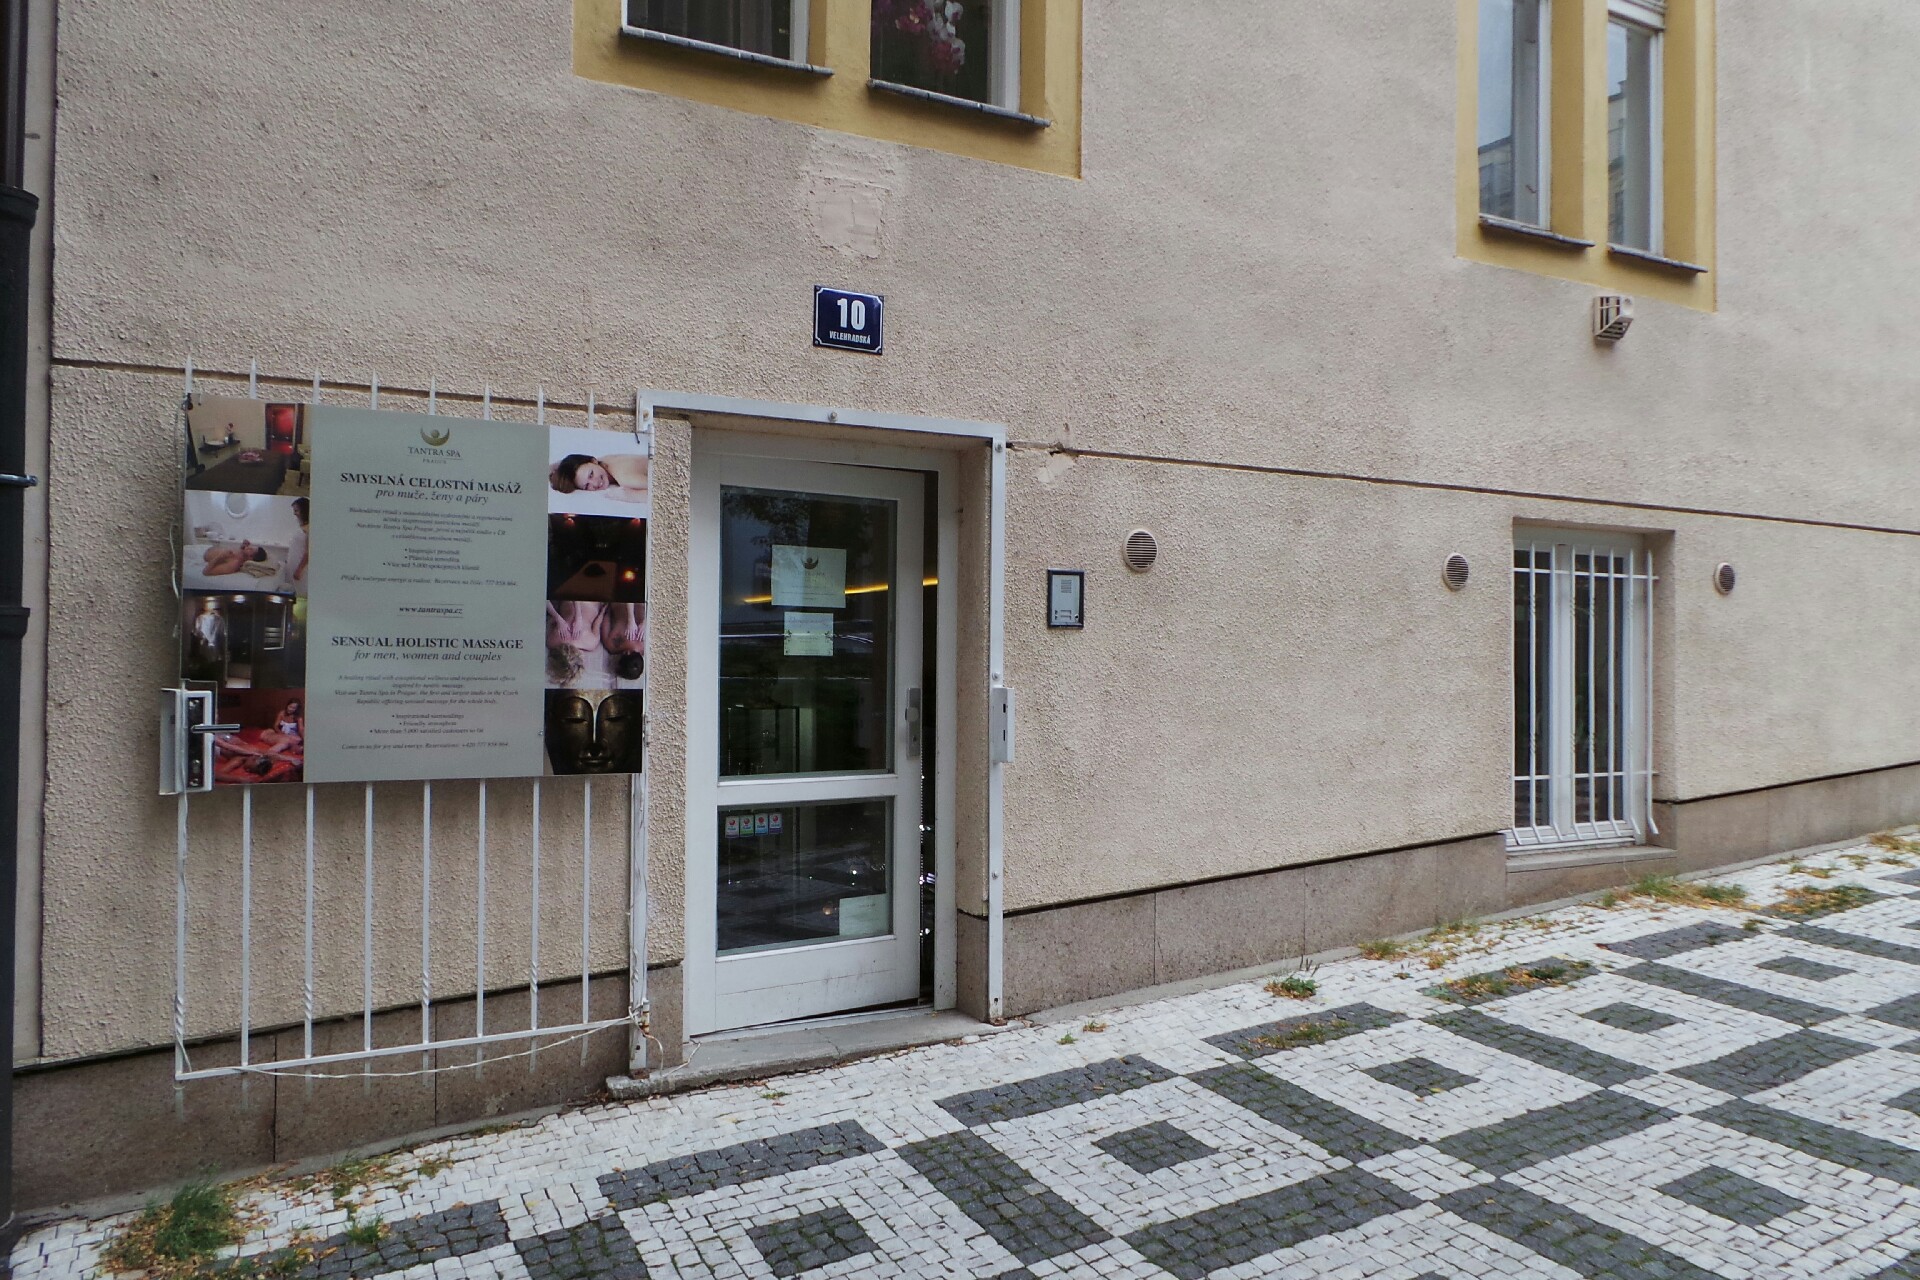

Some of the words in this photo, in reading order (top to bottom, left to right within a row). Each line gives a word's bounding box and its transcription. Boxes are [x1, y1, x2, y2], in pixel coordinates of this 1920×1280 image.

[837, 298, 866, 331] 10
[829, 331, 871, 344] VELEHRADSKÁ
[407, 446, 444, 456] TANTRA
[446, 449, 461, 458] SPA
[340, 472, 405, 487] SMYSLNÁ
[408, 476, 474, 491] CELOSTNÍ
[477, 481, 522, 494] MASÁŽ
[375, 488, 395, 499] pro
[431, 490, 453, 504] ženy
[465, 494, 489, 505] páry
[399, 607, 463, 615] www.tantraspa.cz
[331, 636, 395, 648] SENSUAL
[395, 637, 459, 649] HOLISTIC
[462, 638, 524, 649] MASSAGE
[354, 649, 371, 662] for
[373, 651, 399, 661] men,
[402, 652, 440, 661] women
[441, 650, 461, 661] and
[463, 651, 502, 663] couples
